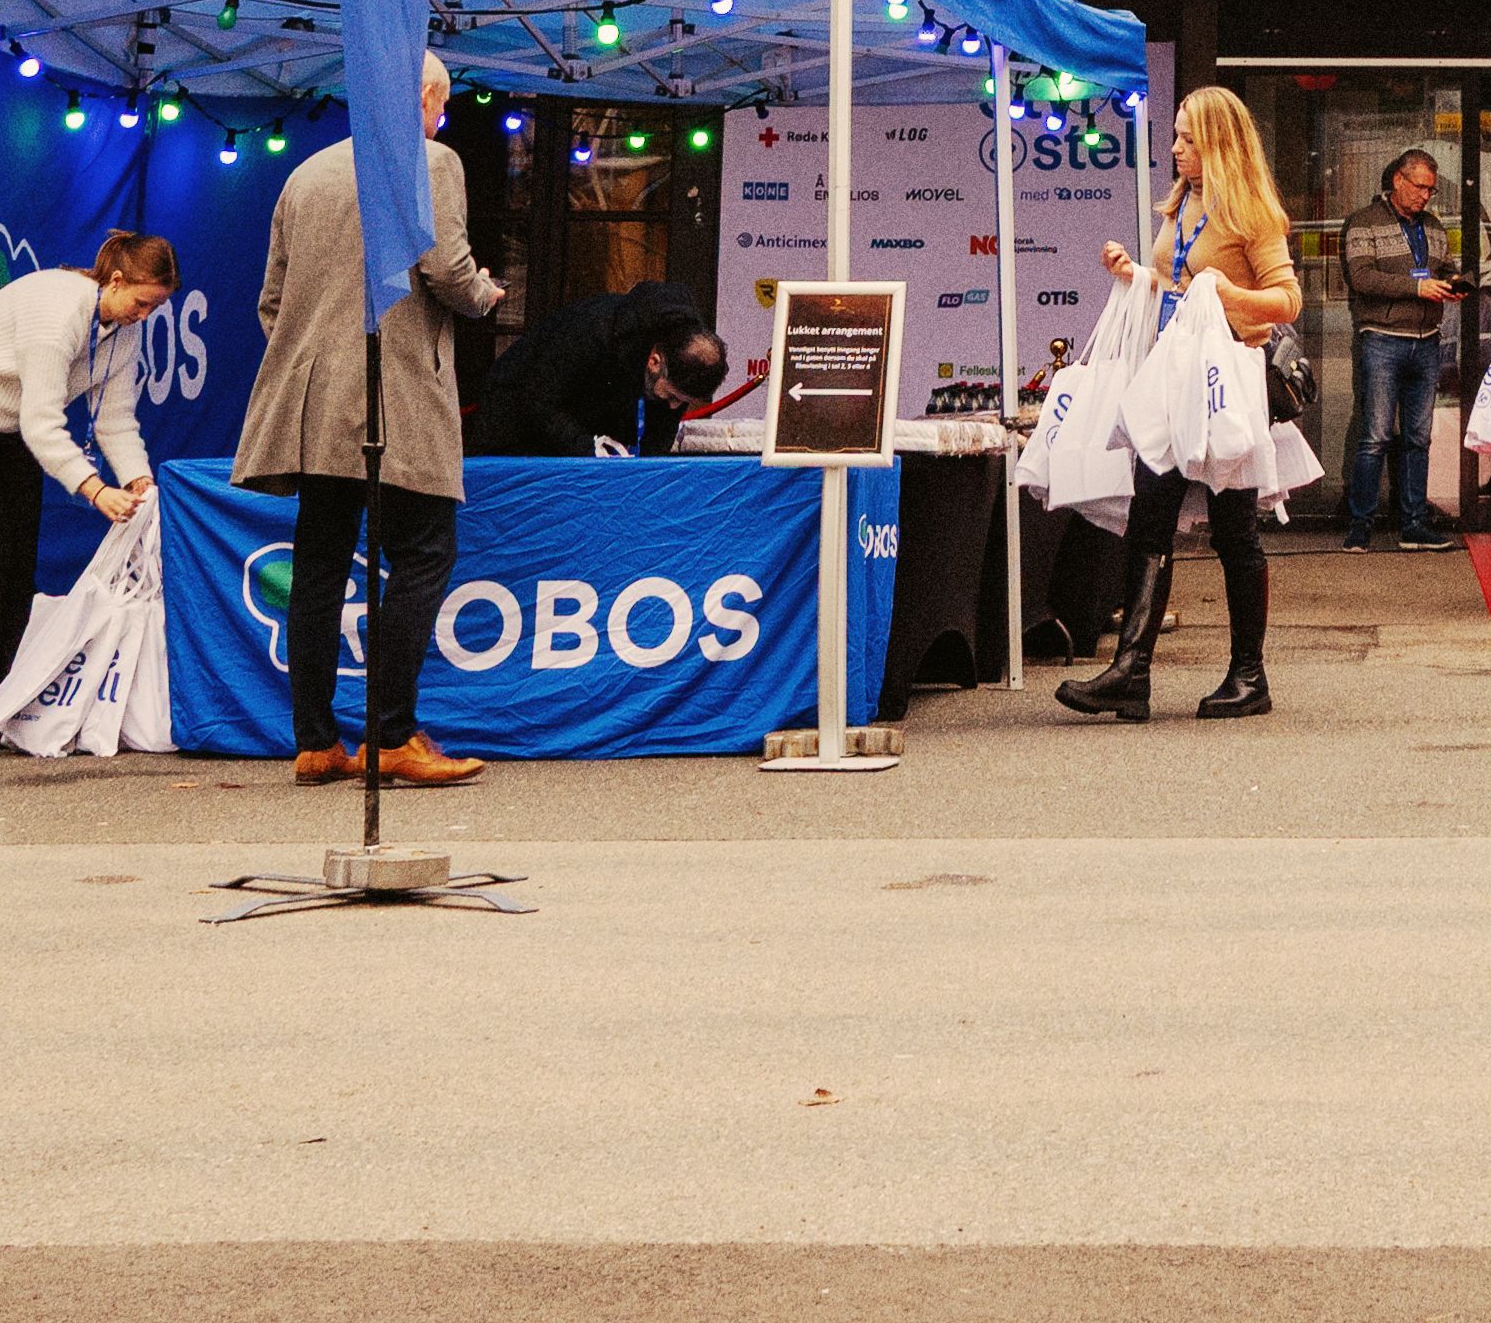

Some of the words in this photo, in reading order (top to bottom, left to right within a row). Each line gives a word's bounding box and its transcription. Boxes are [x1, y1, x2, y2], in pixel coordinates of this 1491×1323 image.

[787, 130, 818, 143] Røde
[744, 184, 788, 199] KONE
[1020, 188, 1049, 201] med
[1074, 187, 1112, 201] OBOS
[756, 234, 827, 249] Anticimex
[870, 238, 925, 250] MAXBO
[1037, 290, 1079, 306] OTIS
[787, 325, 820, 336] Lukket
[821, 326, 883, 338] arrangement
[136, 289, 208, 405] OS
[433, 573, 764, 671] OBOS
